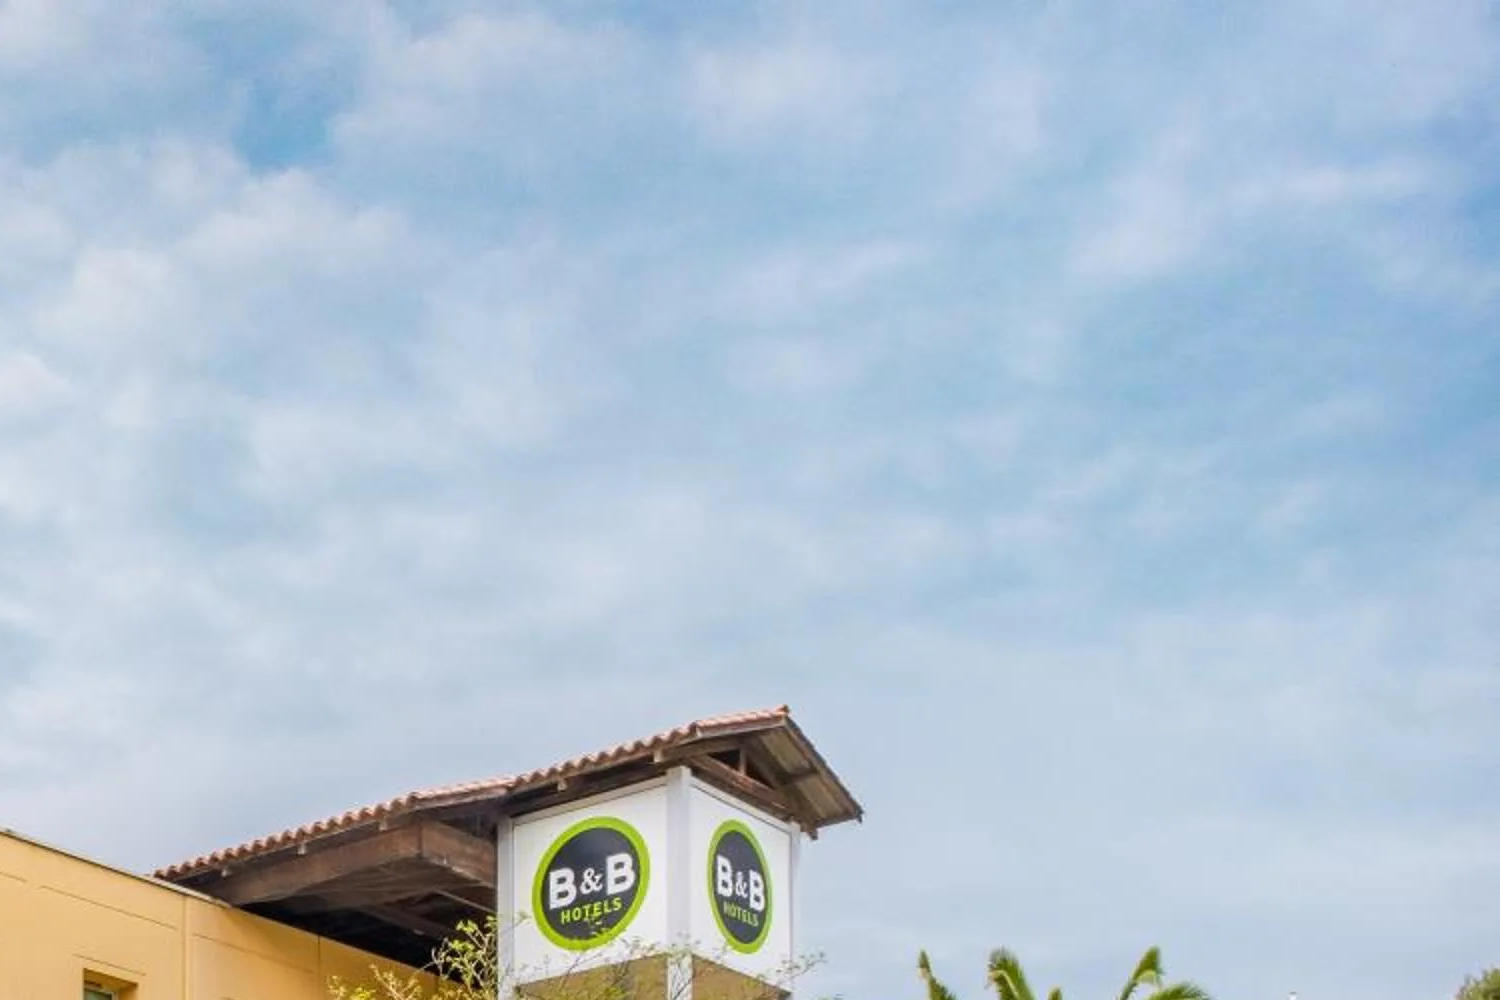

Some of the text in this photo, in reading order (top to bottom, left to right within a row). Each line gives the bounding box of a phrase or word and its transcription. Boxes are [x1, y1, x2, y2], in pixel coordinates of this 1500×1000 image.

[548, 852, 636, 910] B&B
[716, 854, 766, 912] B&B
[560, 896, 622, 925] HOTELS
[723, 900, 759, 928] HOTELS
